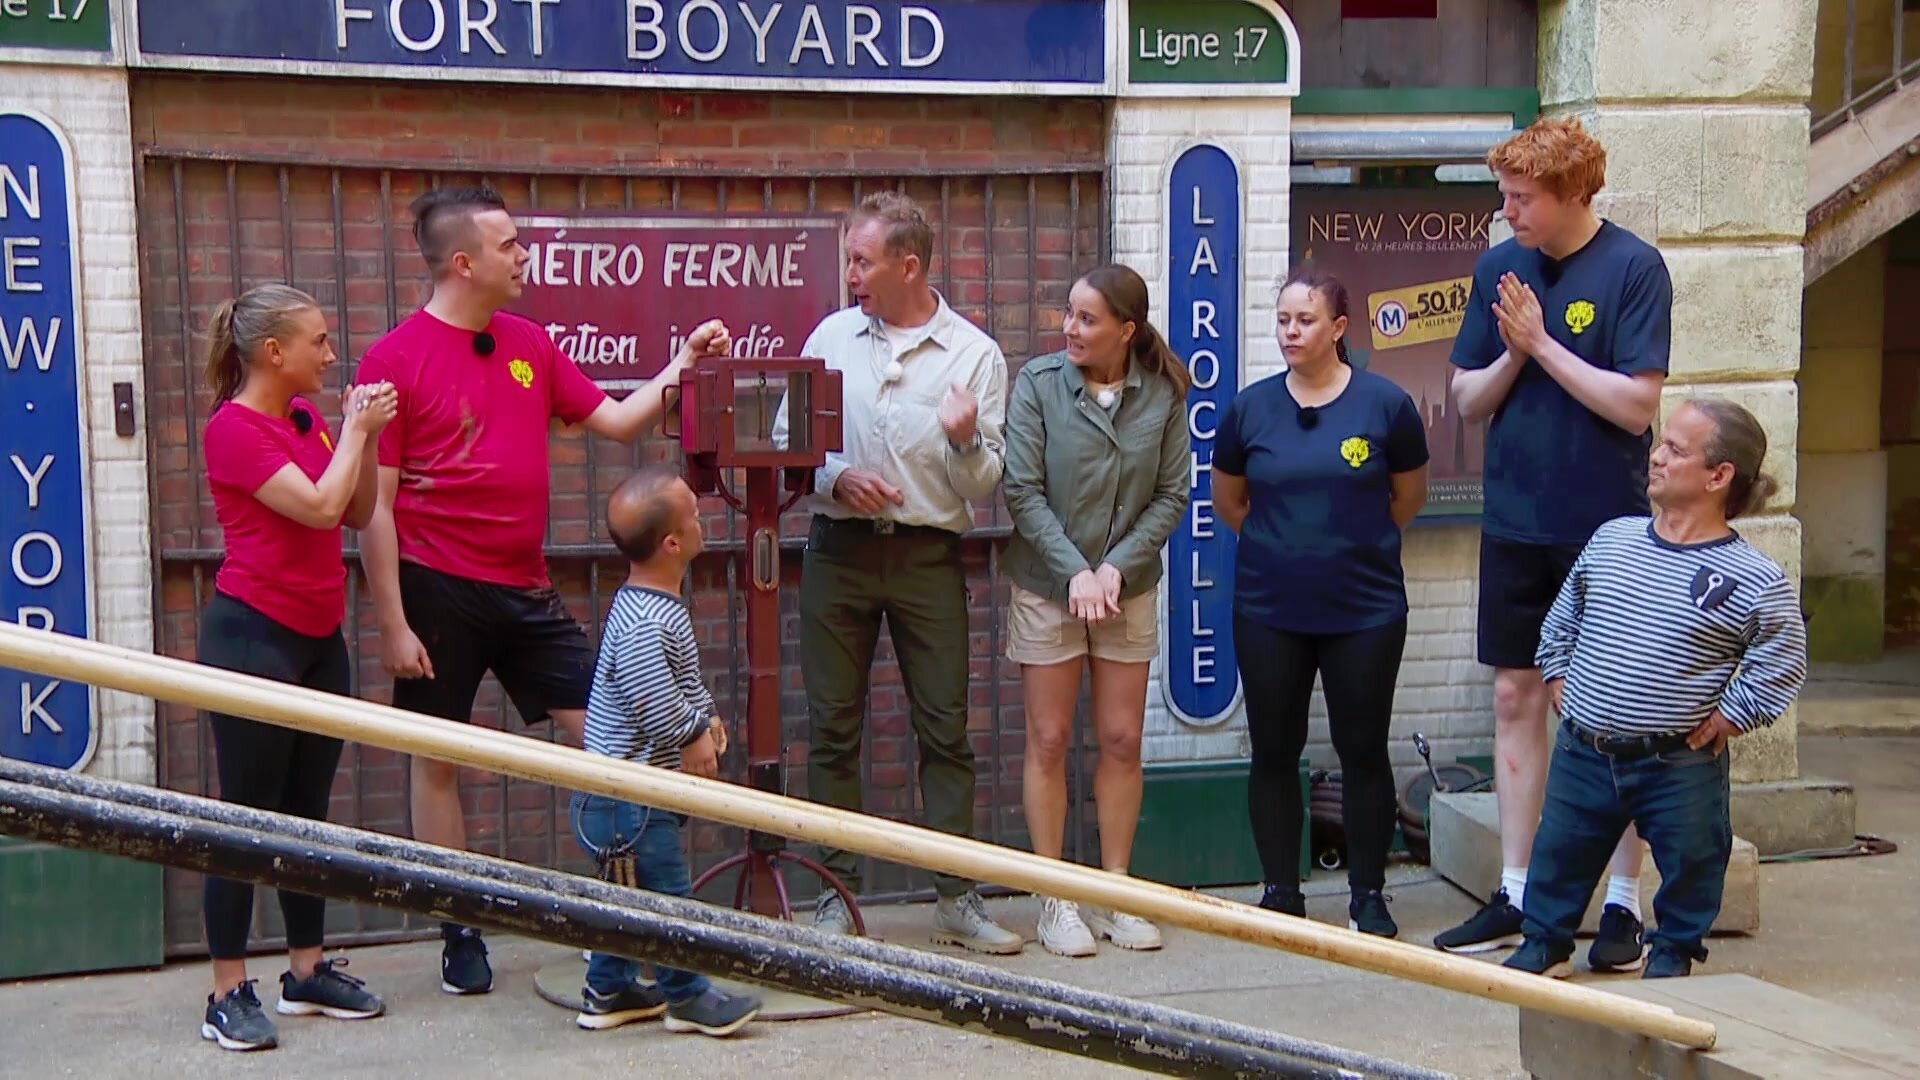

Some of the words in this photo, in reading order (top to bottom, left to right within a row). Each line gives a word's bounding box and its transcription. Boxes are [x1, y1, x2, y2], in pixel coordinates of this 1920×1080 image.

[335, 0, 561, 56] FORT
[626, 1, 945, 68] BOYARD
[1139, 28, 1220, 65] Ligne
[1233, 27, 1268, 64] 17
[1189, 185, 1219, 276] LA
[1310, 213, 1384, 242] NEW
[1398, 212, 1489, 241] YORK
[1385, 241, 1424, 252] HEURES
[663, 230, 808, 287] FERMÉ
[1381, 308, 1402, 332] M
[545, 322, 638, 366] tation
[1187, 300, 1221, 684] ROCHELLE
